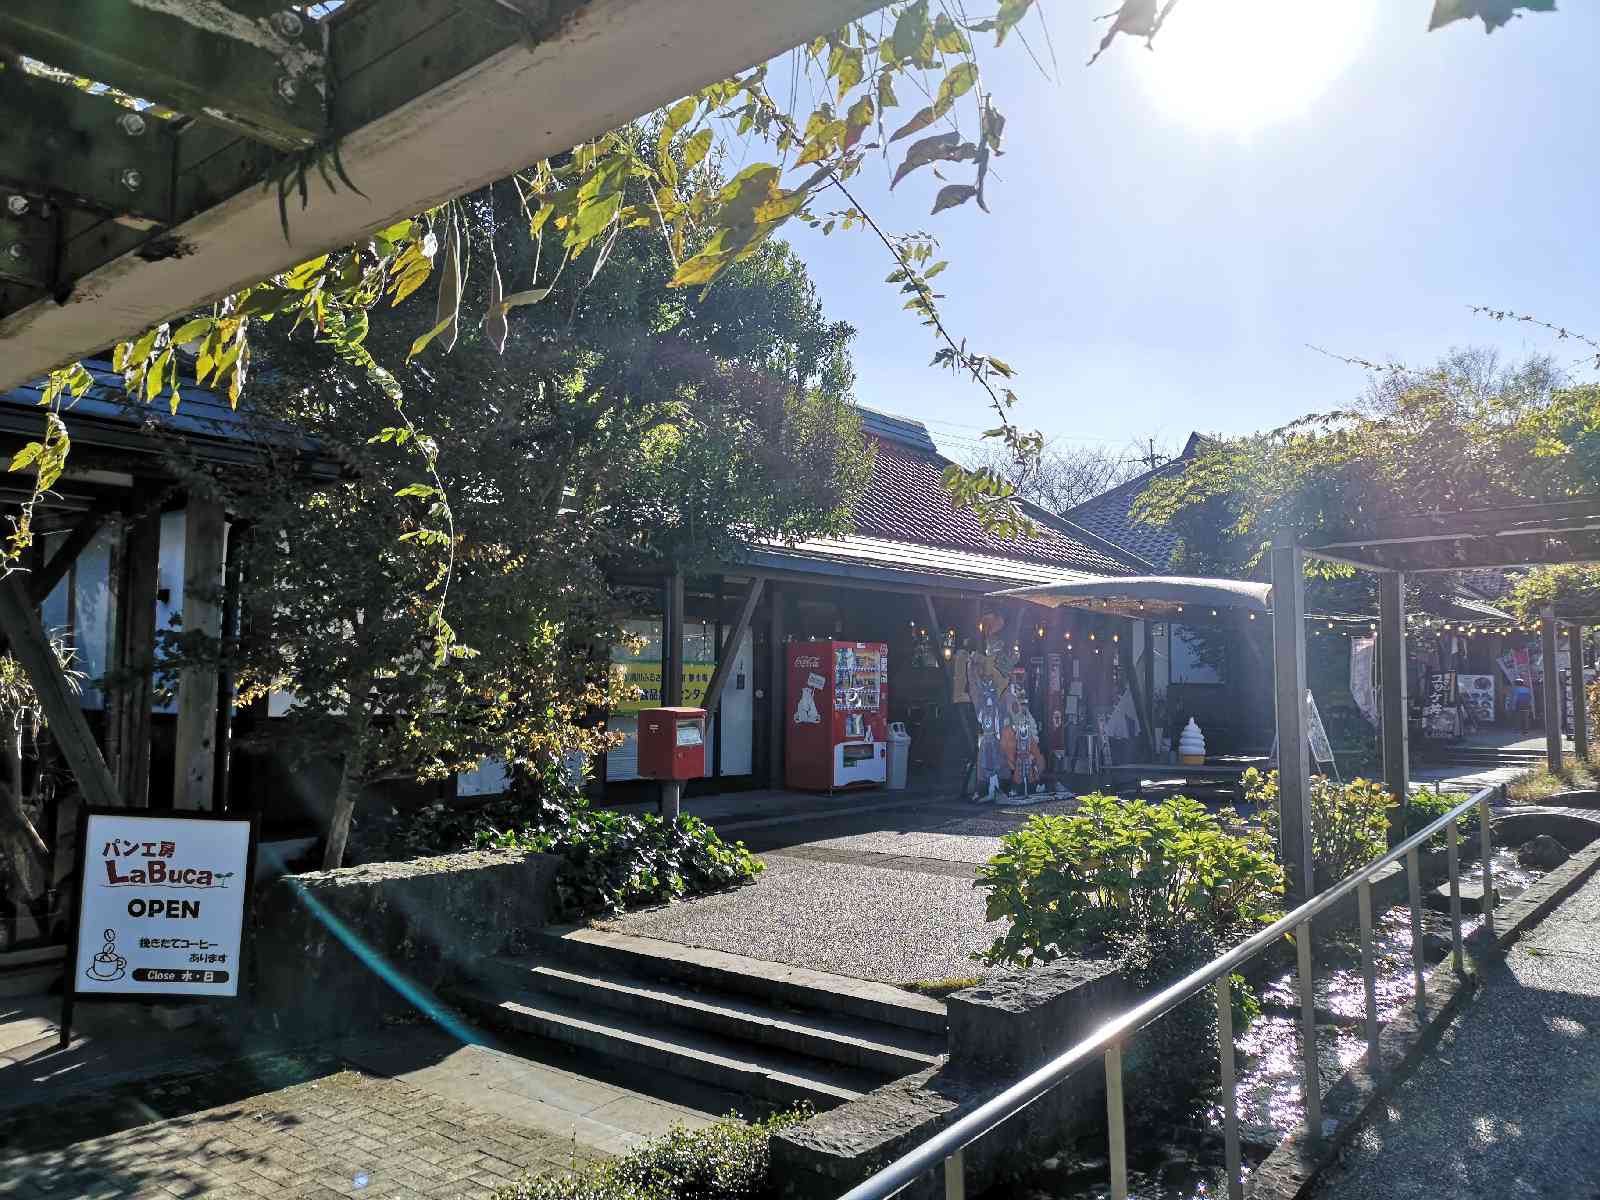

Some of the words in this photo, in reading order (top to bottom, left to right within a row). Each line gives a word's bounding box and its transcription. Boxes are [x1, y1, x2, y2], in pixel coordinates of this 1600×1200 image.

[102, 838, 176, 858] パン工房
[105, 859, 213, 886] LaBuca
[127, 898, 201, 919] OPEN
[139, 937, 218, 950] 挽きたてコーヒー
[189, 953, 227, 964] あります
[147, 969, 175, 980] Close
